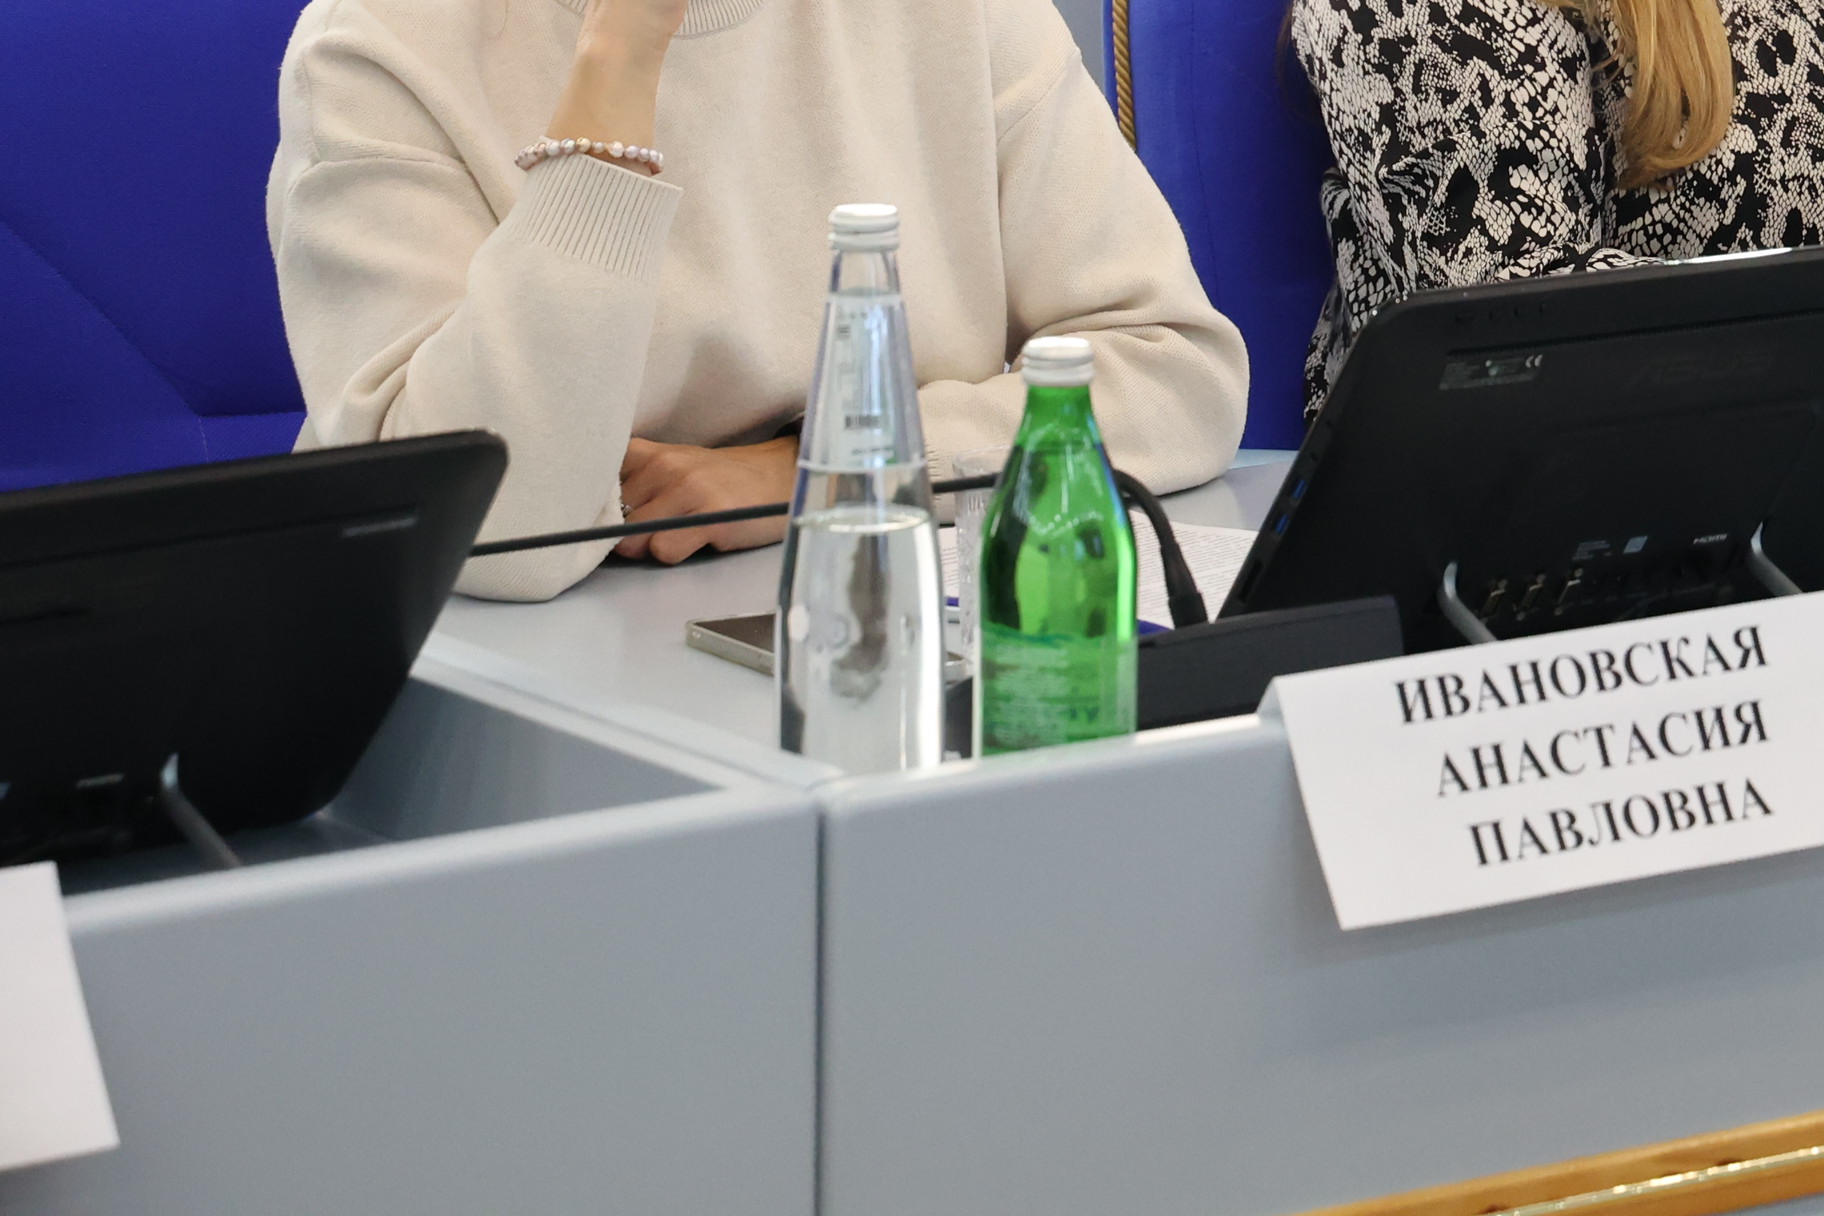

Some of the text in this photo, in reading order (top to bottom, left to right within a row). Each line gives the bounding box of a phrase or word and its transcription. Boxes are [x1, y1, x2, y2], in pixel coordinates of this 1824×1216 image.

[1395, 625, 1768, 724] ИВАНОВСКАЯ
[1437, 700, 1769, 797] АНАСТАСИЯ
[1469, 779, 1773, 867] ПАВЛОВНА
